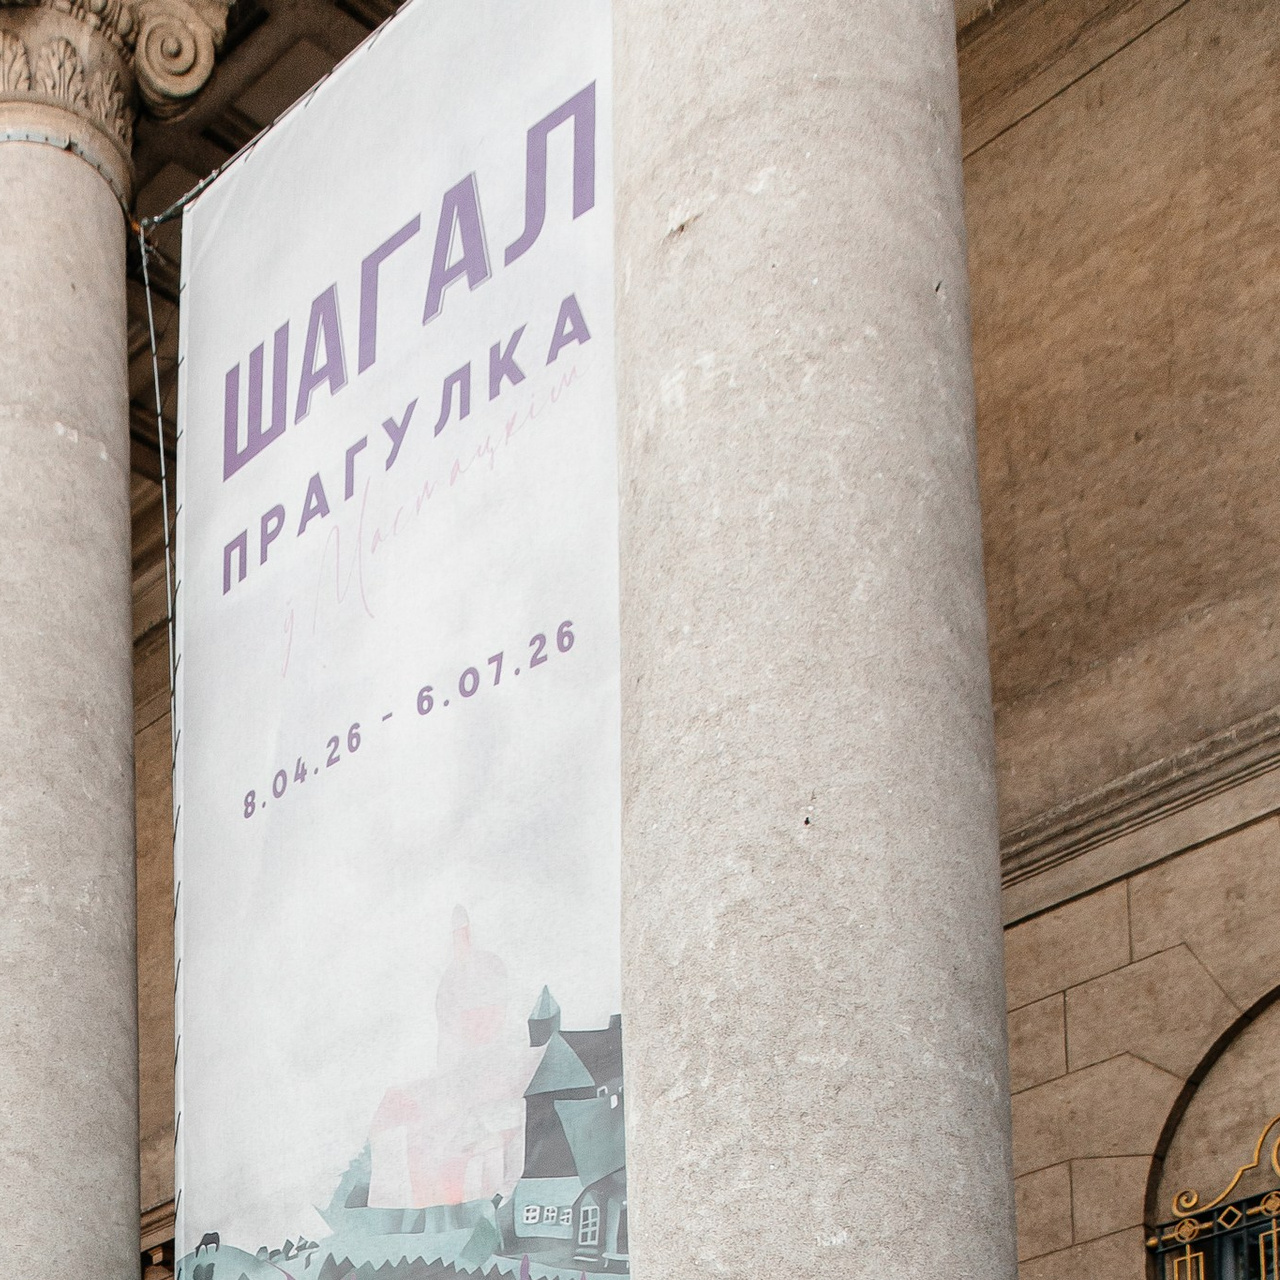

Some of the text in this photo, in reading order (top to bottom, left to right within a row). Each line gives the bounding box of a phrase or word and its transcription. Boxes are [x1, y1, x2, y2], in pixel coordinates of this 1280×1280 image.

[223, 79, 596, 482] ШАГАЛ
[223, 292, 592, 595] ПРАГУЛКА
[243, 722, 362, 819] 8.04.26
[416, 620, 575, 715] 6.07.26
